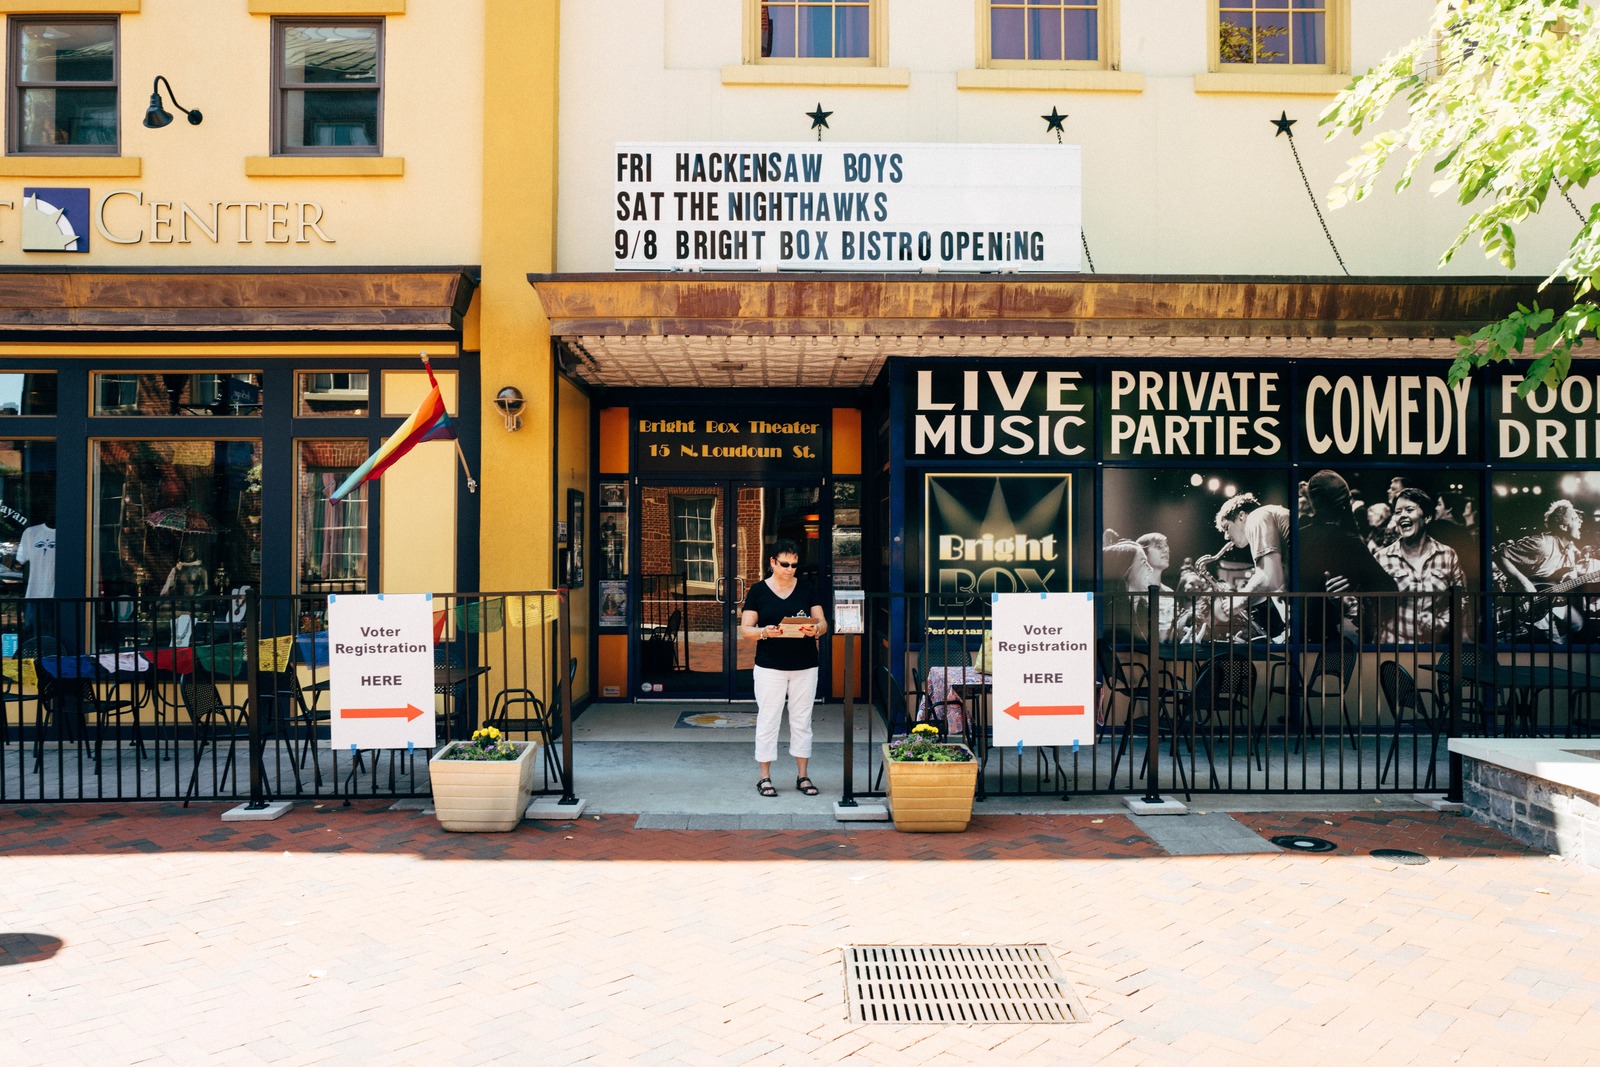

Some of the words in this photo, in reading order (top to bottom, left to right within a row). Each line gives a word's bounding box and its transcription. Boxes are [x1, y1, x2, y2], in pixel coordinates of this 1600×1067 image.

[618, 153, 651, 182] FRI
[676, 152, 822, 182] HACKENSAW
[844, 153, 902, 183] BOYS
[617, 191, 664, 221] SAT
[674, 192, 719, 221] THE
[729, 192, 887, 221] NIGHTHAWKS
[615, 229, 657, 259] 9/8
[676, 230, 765, 260] BRIGHT
[781, 230, 828, 260] BOX
[842, 231, 931, 261] BISTRO
[918, 371, 1084, 411] LIVE
[1112, 371, 1280, 411] PRIVATE
[1502, 375, 1600, 414] FOO
[639, 419, 696, 433] Bright
[706, 420, 740, 434] Box
[748, 420, 820, 434] Theater
[1305, 375, 1473, 455] COMEDY
[915, 415, 1085, 455] MUSIC
[1111, 415, 1280, 455] PARTIES
[1499, 419, 1600, 458] DRI
[649, 444, 671, 457] 15
[680, 444, 699, 458] N.
[701, 444, 782, 458] Loudoun
[792, 444, 816, 459] St.
[938, 533, 1059, 562] Bright
[938, 566, 1056, 607] BOX
[360, 626, 401, 637] Voter
[1023, 624, 1063, 635] Voter
[335, 642, 427, 656] Registration
[998, 641, 1087, 654] Registration
[361, 675, 402, 686] HERE
[1023, 673, 1063, 683] HERE
